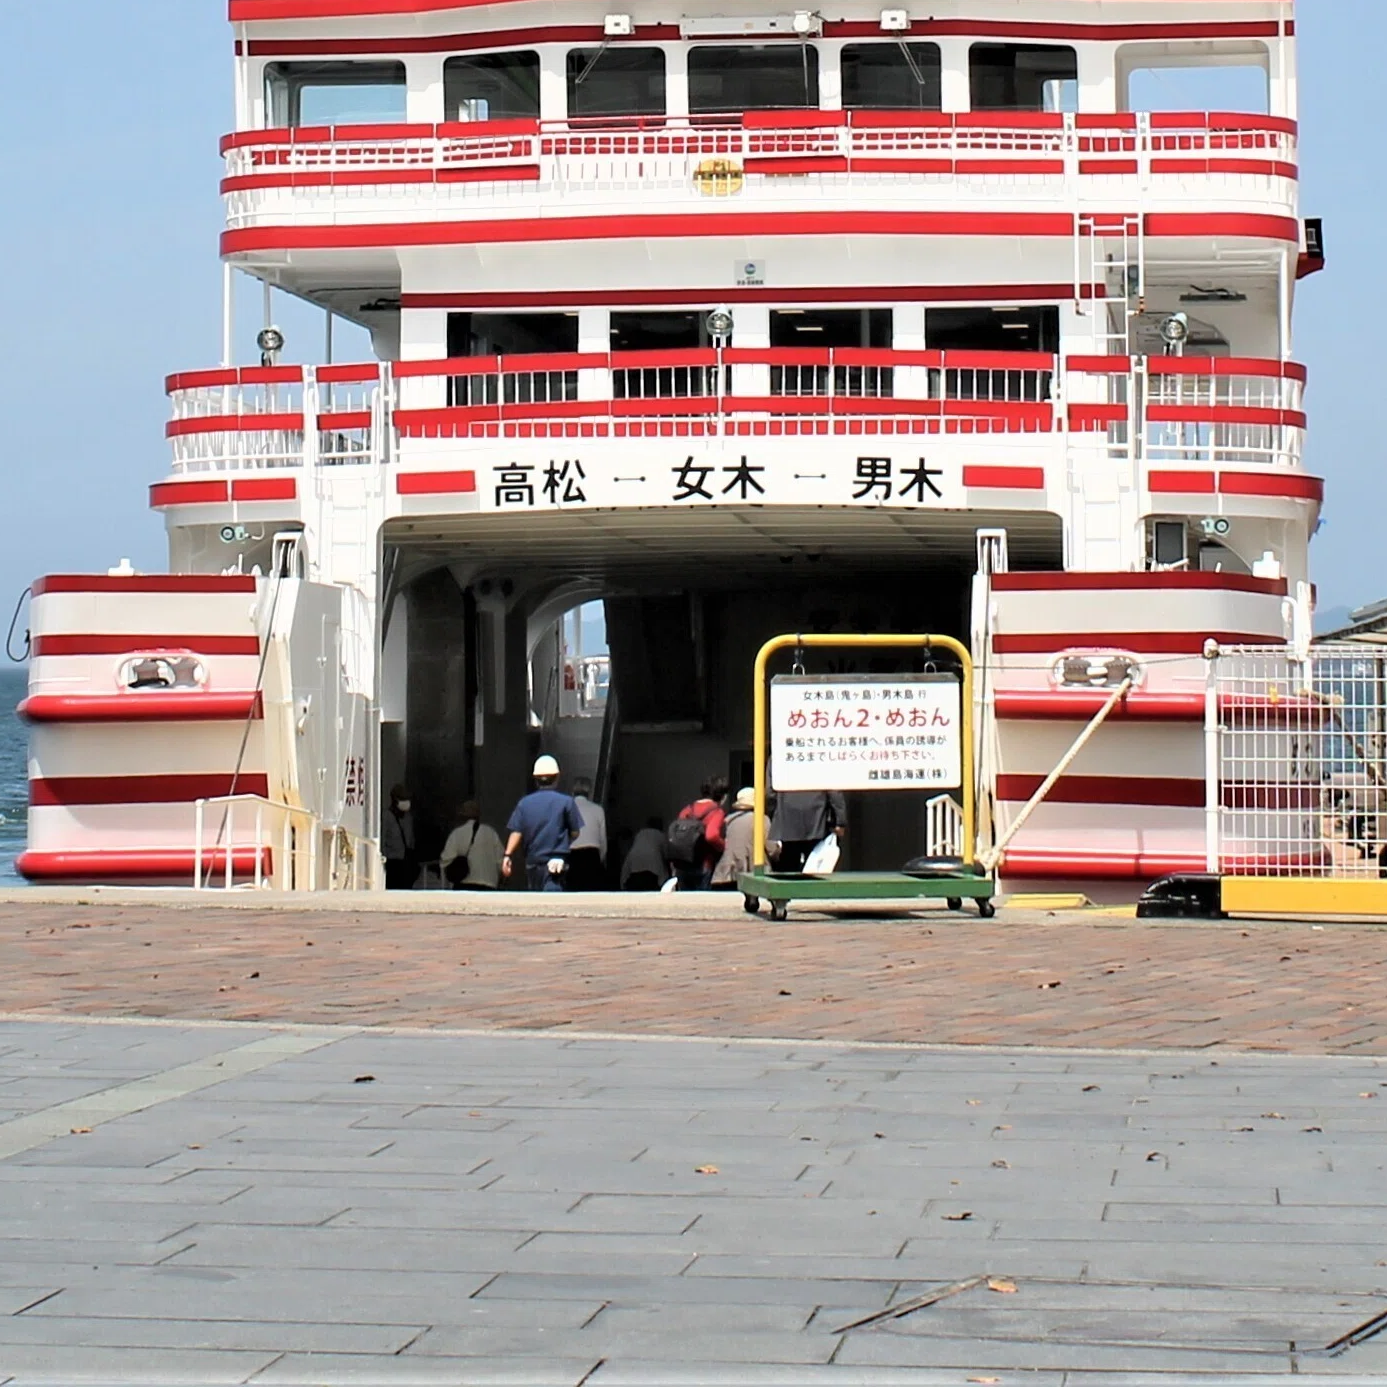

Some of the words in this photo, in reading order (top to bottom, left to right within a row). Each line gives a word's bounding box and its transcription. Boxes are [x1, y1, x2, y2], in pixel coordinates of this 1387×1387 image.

[493, 459, 587, 507] 高松
[671, 455, 766, 502] 女木
[851, 456, 943, 504] 男木
